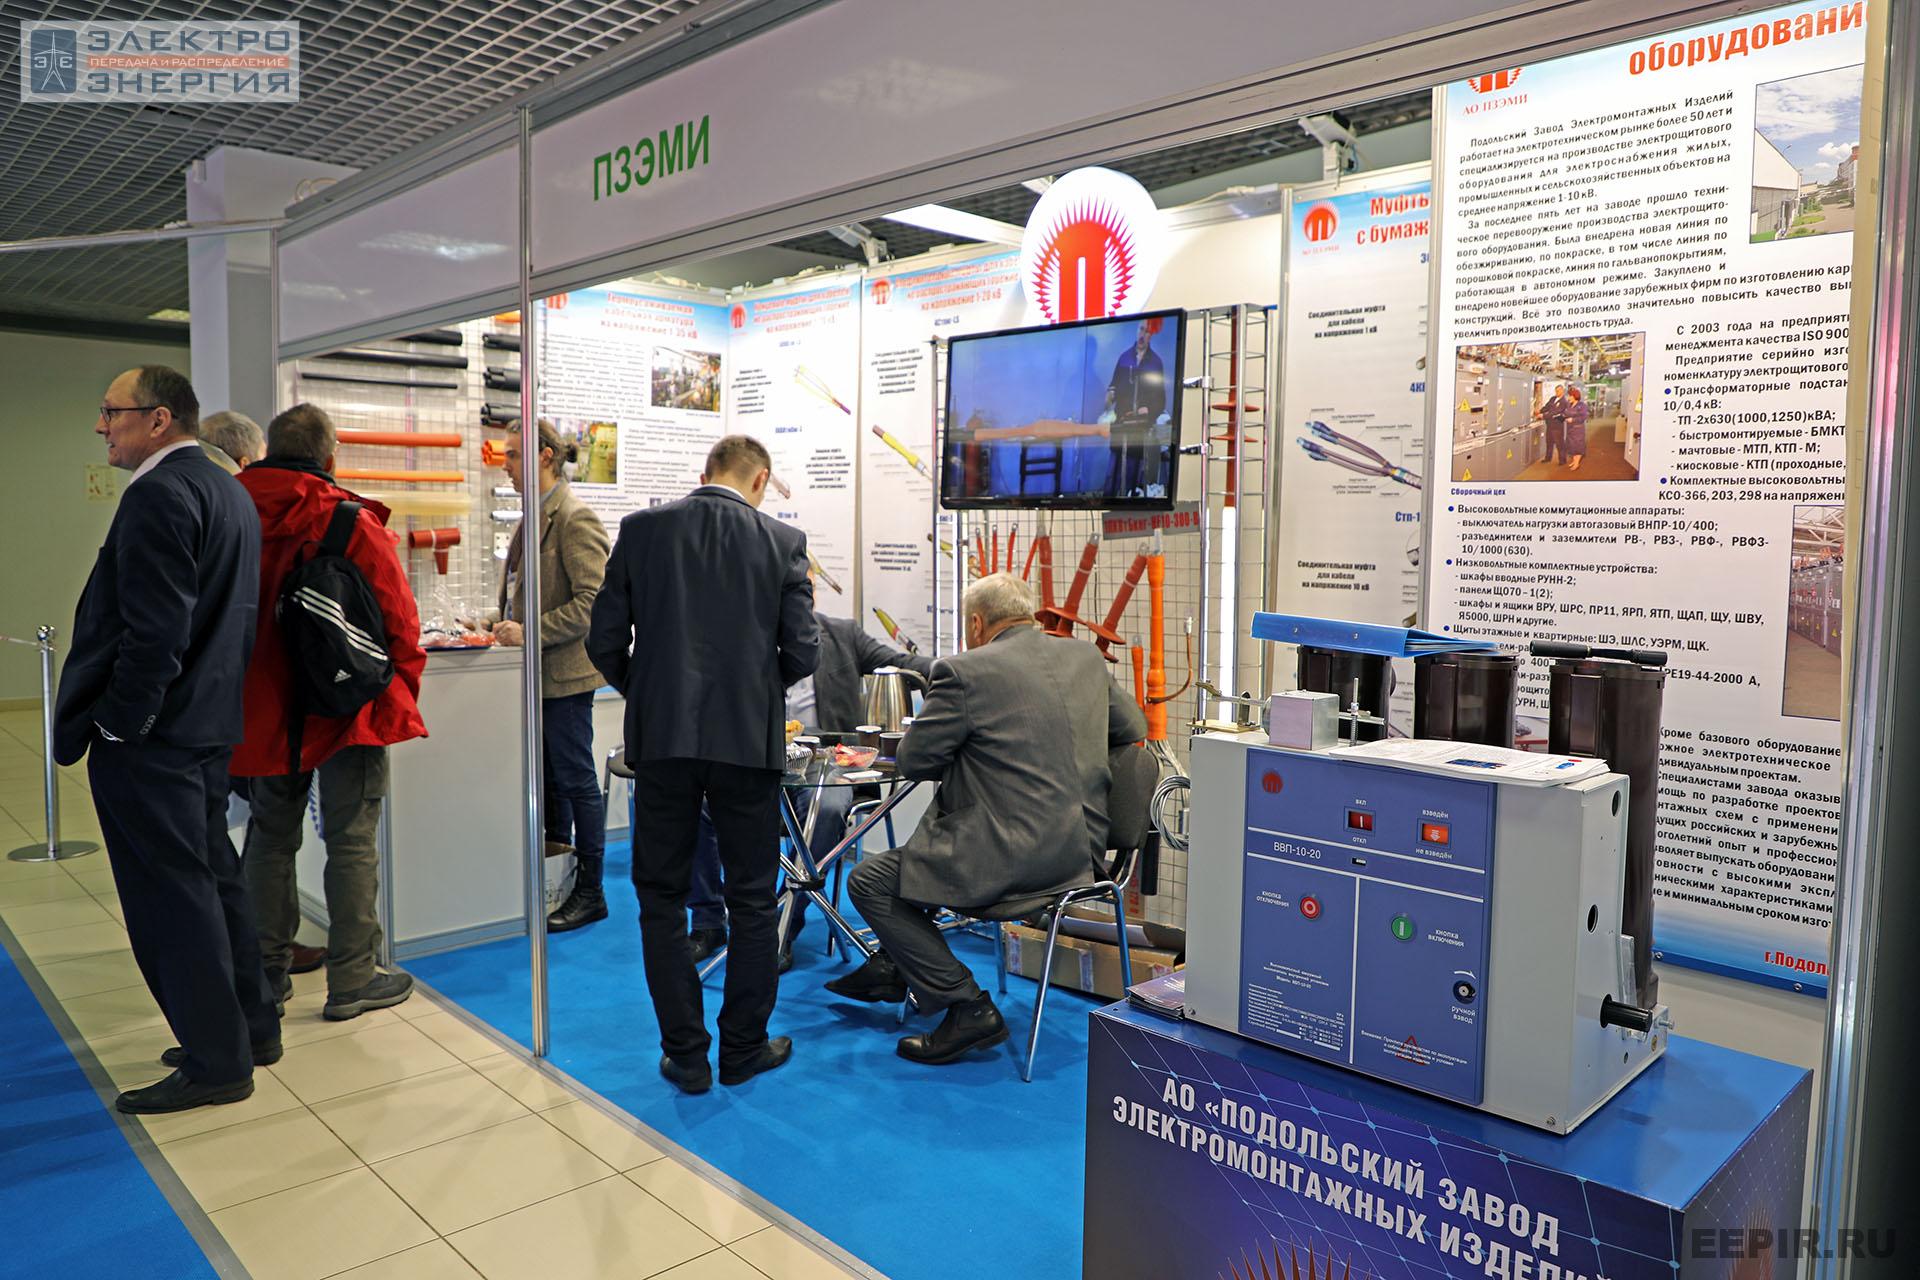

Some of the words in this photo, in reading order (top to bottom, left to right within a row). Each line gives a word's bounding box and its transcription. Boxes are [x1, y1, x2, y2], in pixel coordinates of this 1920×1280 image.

[1629, 1, 1868, 76] оборудовани
[1470, 131, 1526, 146] Подольский
[1533, 124, 1563, 135] Завод
[1570, 102, 1676, 128] Электромонтажных
[1684, 89, 1733, 107] Изделий
[1459, 149, 1501, 163] работает
[1516, 128, 1618, 152] электротехническом
[1620, 121, 1654, 136] рынке
[1656, 115, 1688, 127] более
[1689, 110, 1704, 121] 50
[1705, 108, 1724, 118] лет
[594, 114, 709, 201] ПЗЭМИ
[1455, 285, 1515, 299] работающая
[1533, 277, 1595, 290] автономном
[1653, 264, 1711, 277] Закуплено
[1719, 262, 1726, 270] и
[1676, 325, 1684, 335] С
[1690, 322, 1719, 333] 2003
[1726, 322, 1752, 331] года
[1759, 320, 1774, 328] на
[1665, 338, 1743, 350] менеджмента
[1745, 333, 1800, 344] качества
[1802, 329, 1823, 340] ISO
[1675, 353, 1752, 366] Предприятие
[1761, 347, 1814, 361] серийно
[1664, 369, 1742, 380] номенклатуру
[1743, 363, 1848, 376] электрощитового
[1673, 382, 1790, 396] Трансформаторные
[1663, 399, 1702, 411] 10/0,4
[1679, 429, 1802, 441] быстромонтируемые
[1678, 446, 1735, 455] мачтовые
[1774, 442, 1797, 453] КТП
[1670, 475, 1746, 485] Комплектные
[1738, 490, 1761, 500] 298
[1763, 492, 1777, 500] на
[1457, 504, 1537, 513] Высоковольтные
[1538, 506, 1627, 515] коммутационные
[1462, 520, 1524, 528] выключатель
[1525, 521, 1568, 529] нагрузки
[1569, 520, 1636, 529] автогазовый
[1461, 533, 1532, 542] разъединители
[1551, 535, 1616, 543] заземлители
[1455, 557, 1527, 568] Низковольтные
[1528, 562, 1594, 571] комплектные
[1460, 572, 1493, 582] шкафы
[1495, 574, 1536, 583] вводные
[1459, 599, 1492, 609] шкафы
[1502, 602, 1533, 610] ящики
[1698, 730, 1750, 745] базового
[1756, 737, 1841, 756] оборудование
[1692, 791, 1705, 800] по
[1711, 794, 1778, 810] разработке
[1785, 805, 1840, 820] проектов
[1690, 821, 1756, 838] российских
[1273, 841, 1321, 860] ВВП-10-20
[1696, 851, 1756, 868] выпускать
[1726, 871, 1791, 889] высокими
[1671, 891, 1754, 913] минимальным
[1755, 907, 1800, 922] сроком
[1720, 885, 1835, 916] характеристиками
[1764, 950, 1829, 976] г.Подол
[1451, 1005, 1475, 1017] ручной
[1113, 1095, 1427, 1245] ЭЛЕКТРОМОНТАЖНЫХ
[1163, 1078, 1195, 1112] АО
[1205, 1097, 1425, 1200] «ПОДОЛЬСКИЙ
[1438, 1177, 1559, 1257] ЗАВОД
